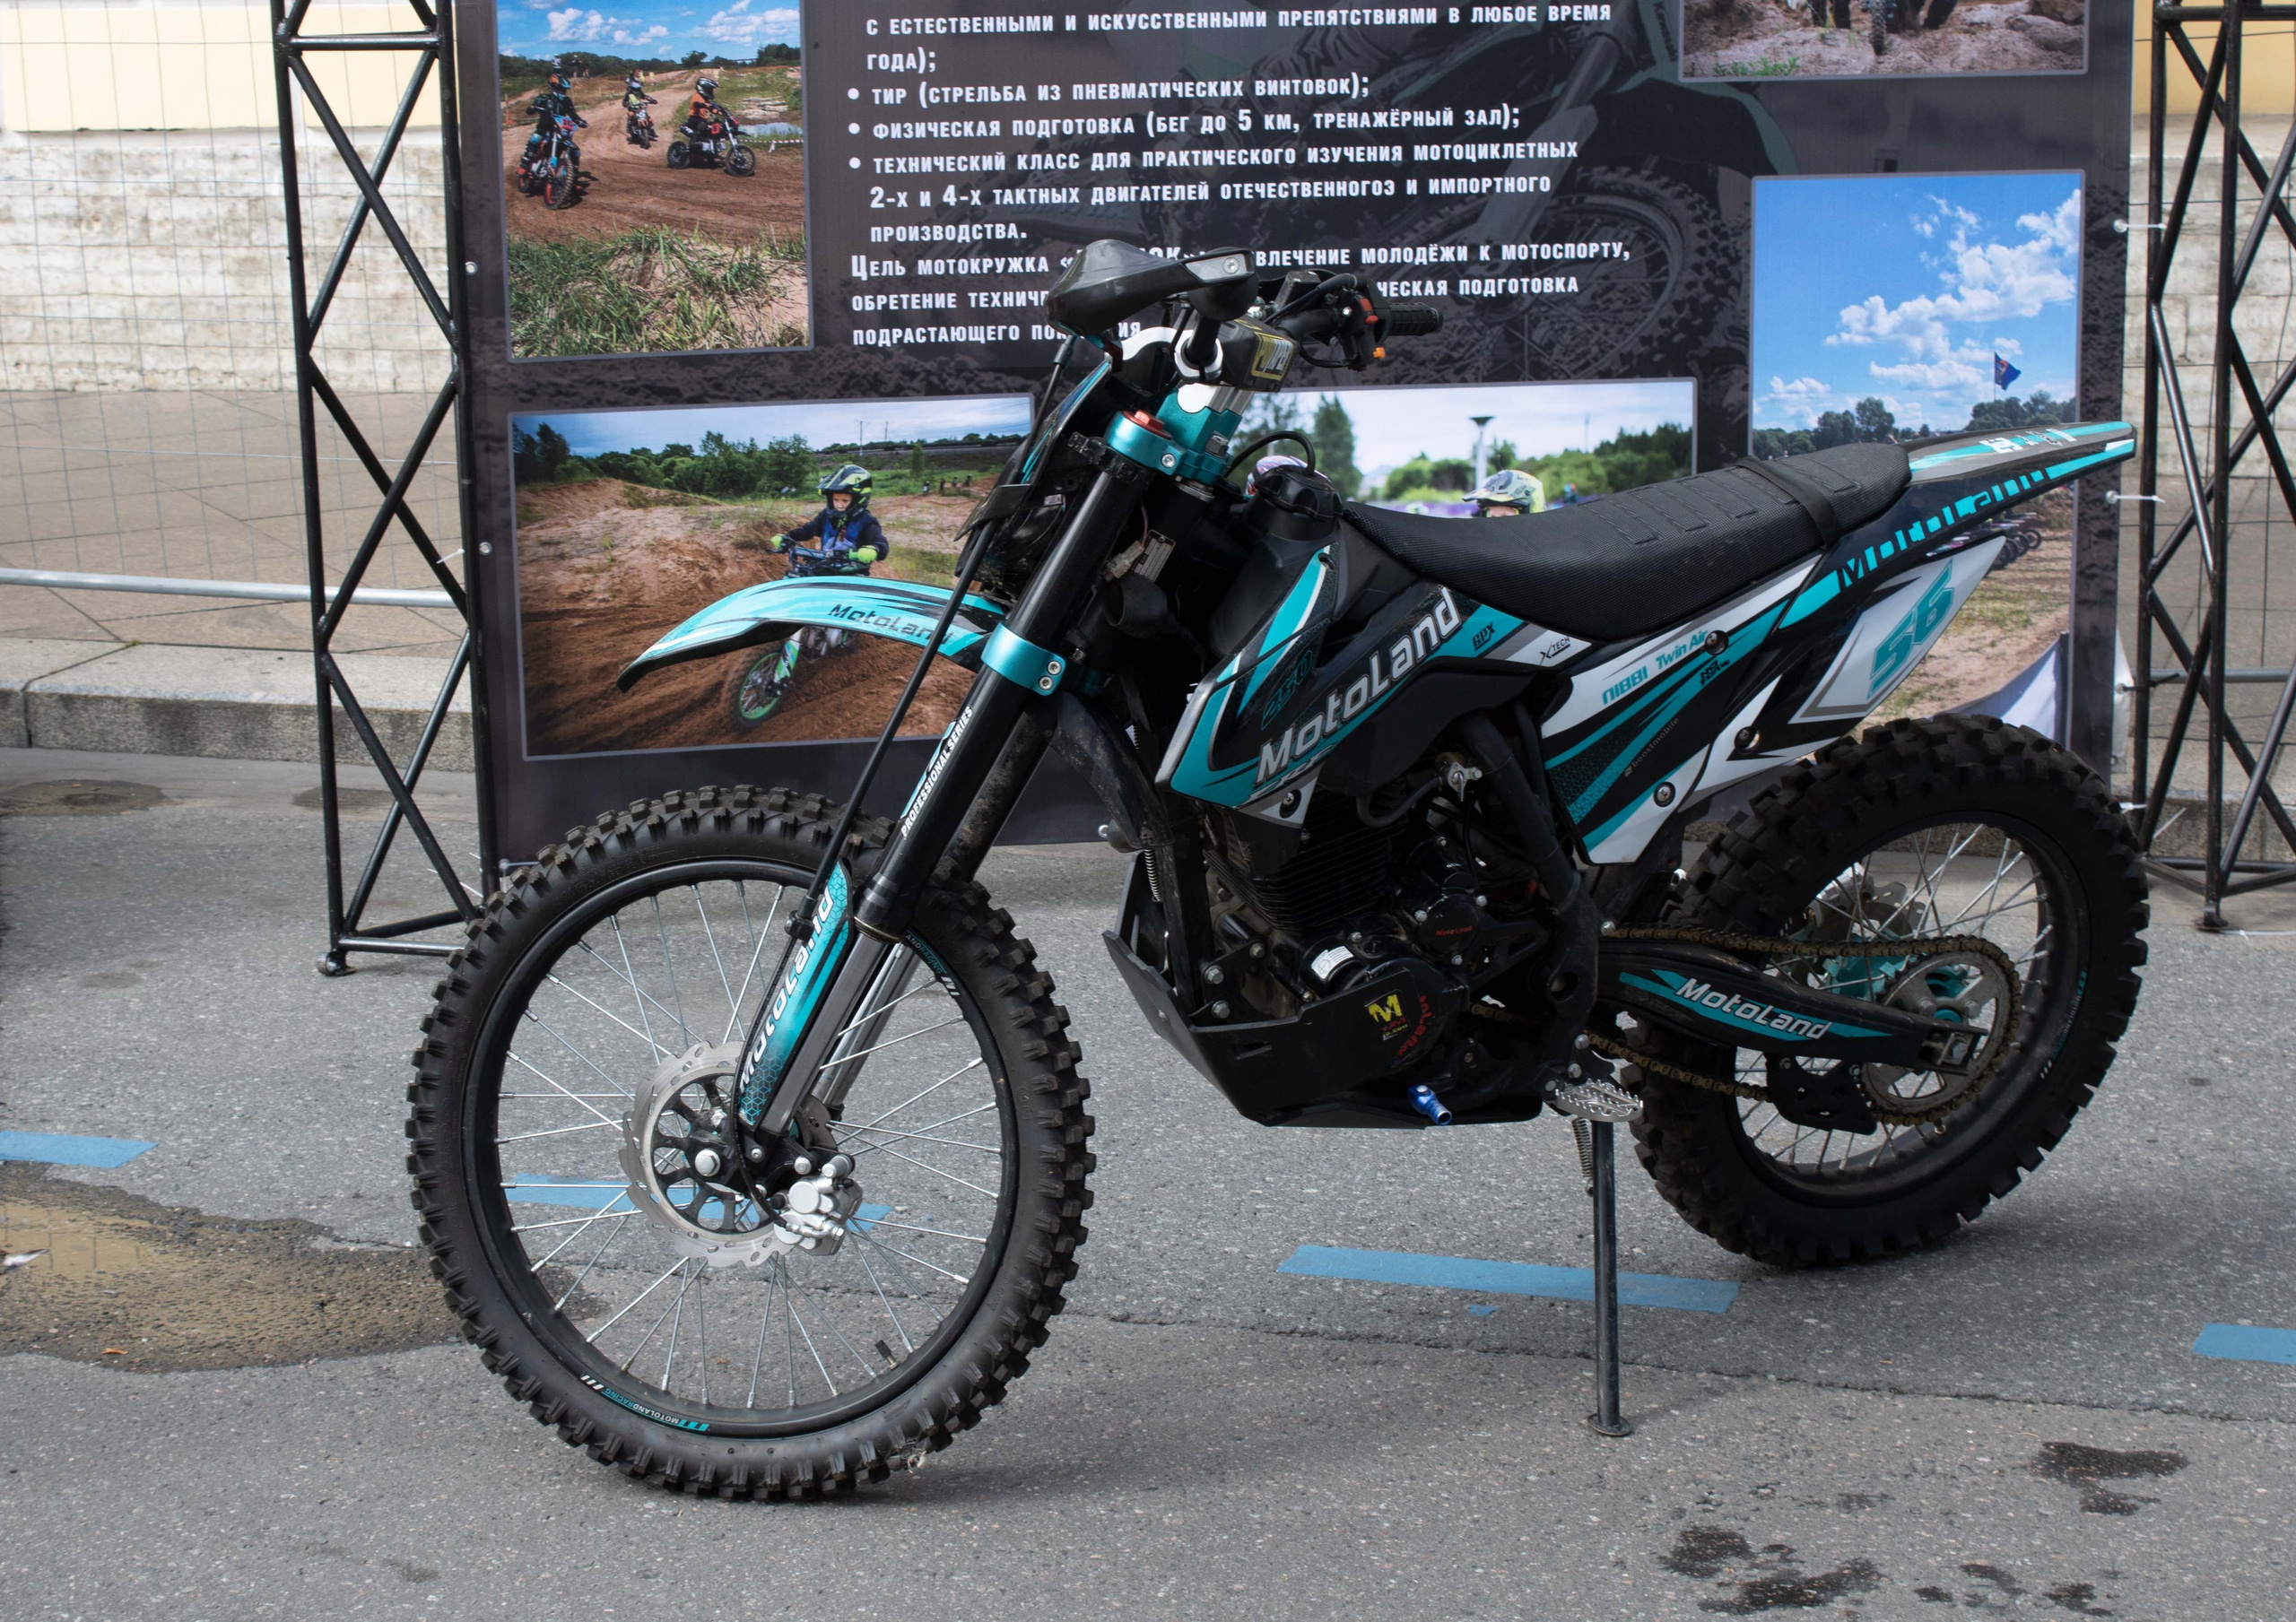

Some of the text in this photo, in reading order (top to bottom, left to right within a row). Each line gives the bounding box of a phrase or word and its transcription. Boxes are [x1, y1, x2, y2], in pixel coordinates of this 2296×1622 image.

[865, 4, 1611, 36] С ЕСТЕСТВЕННЫМИ И ИСКУССТВЕННЫМИ ПРЕПЯТСТВИЯМИ В ЛЮБОЕ ВРЕМЯ
[866, 46, 936, 74] ГОДА);
[871, 71, 1369, 109] ТИР (СТРЕЛЬБА ИЗ ПНЕВМАТИЧЕСКИХ ВИНТОВОК);
[873, 102, 1519, 140] ФИЗИЧЕСКАЯ ПОДГОТОВКА (БЕГ ДО 5 КМ, ТРЕНАЖЁРНЫЙ ЗАЛ);
[873, 141, 1578, 174] ТЕХНИЧЕСКИЙ КЛАСС ДЛЯ ПРАКТИЧЕСКОГО ИЗУЧЕНИЯ МОТОЦИКЛЕТНЫХ
[919, 191, 932, 207] И
[992, 186, 1080, 205] ТАКТНЫХ
[1091, 180, 1209, 206] ДВИГАТЕЛЕЙ
[1406, 178, 1418, 195] И
[1429, 176, 1551, 195] ИМПОРТНОГО
[870, 222, 1027, 244] ПРОИЗВОДСТВА.
[918, 256, 1049, 275] МОТОКРУЖКА
[1255, 248, 1351, 267] ВЛЕЧЕНИЕ
[1361, 243, 1468, 265] МОЛОДЁЖИ
[1479, 245, 1491, 261] К
[1501, 241, 1631, 261] МОТОСПОРТУ,
[851, 292, 957, 312] ОБРЕТЕНИЕ
[1376, 279, 1448, 298] ЧЕСКАЯ
[1459, 276, 1579, 298] ПОДГОТОВКА
[852, 325, 1020, 348] ПОДРАСТАЮЩЕГО
[1866, 558, 1954, 700] 56
[1655, 644, 1688, 670] Twin
[1689, 629, 1708, 651] Air
[1254, 585, 1464, 786] MotoLand
[1631, 717, 1680, 768] boostmobile
[900, 706, 973, 839] PROFESSIONAL SERIES
[906, 933, 944, 975] ANDRACING
[1674, 977, 1834, 1040] MotoLand
